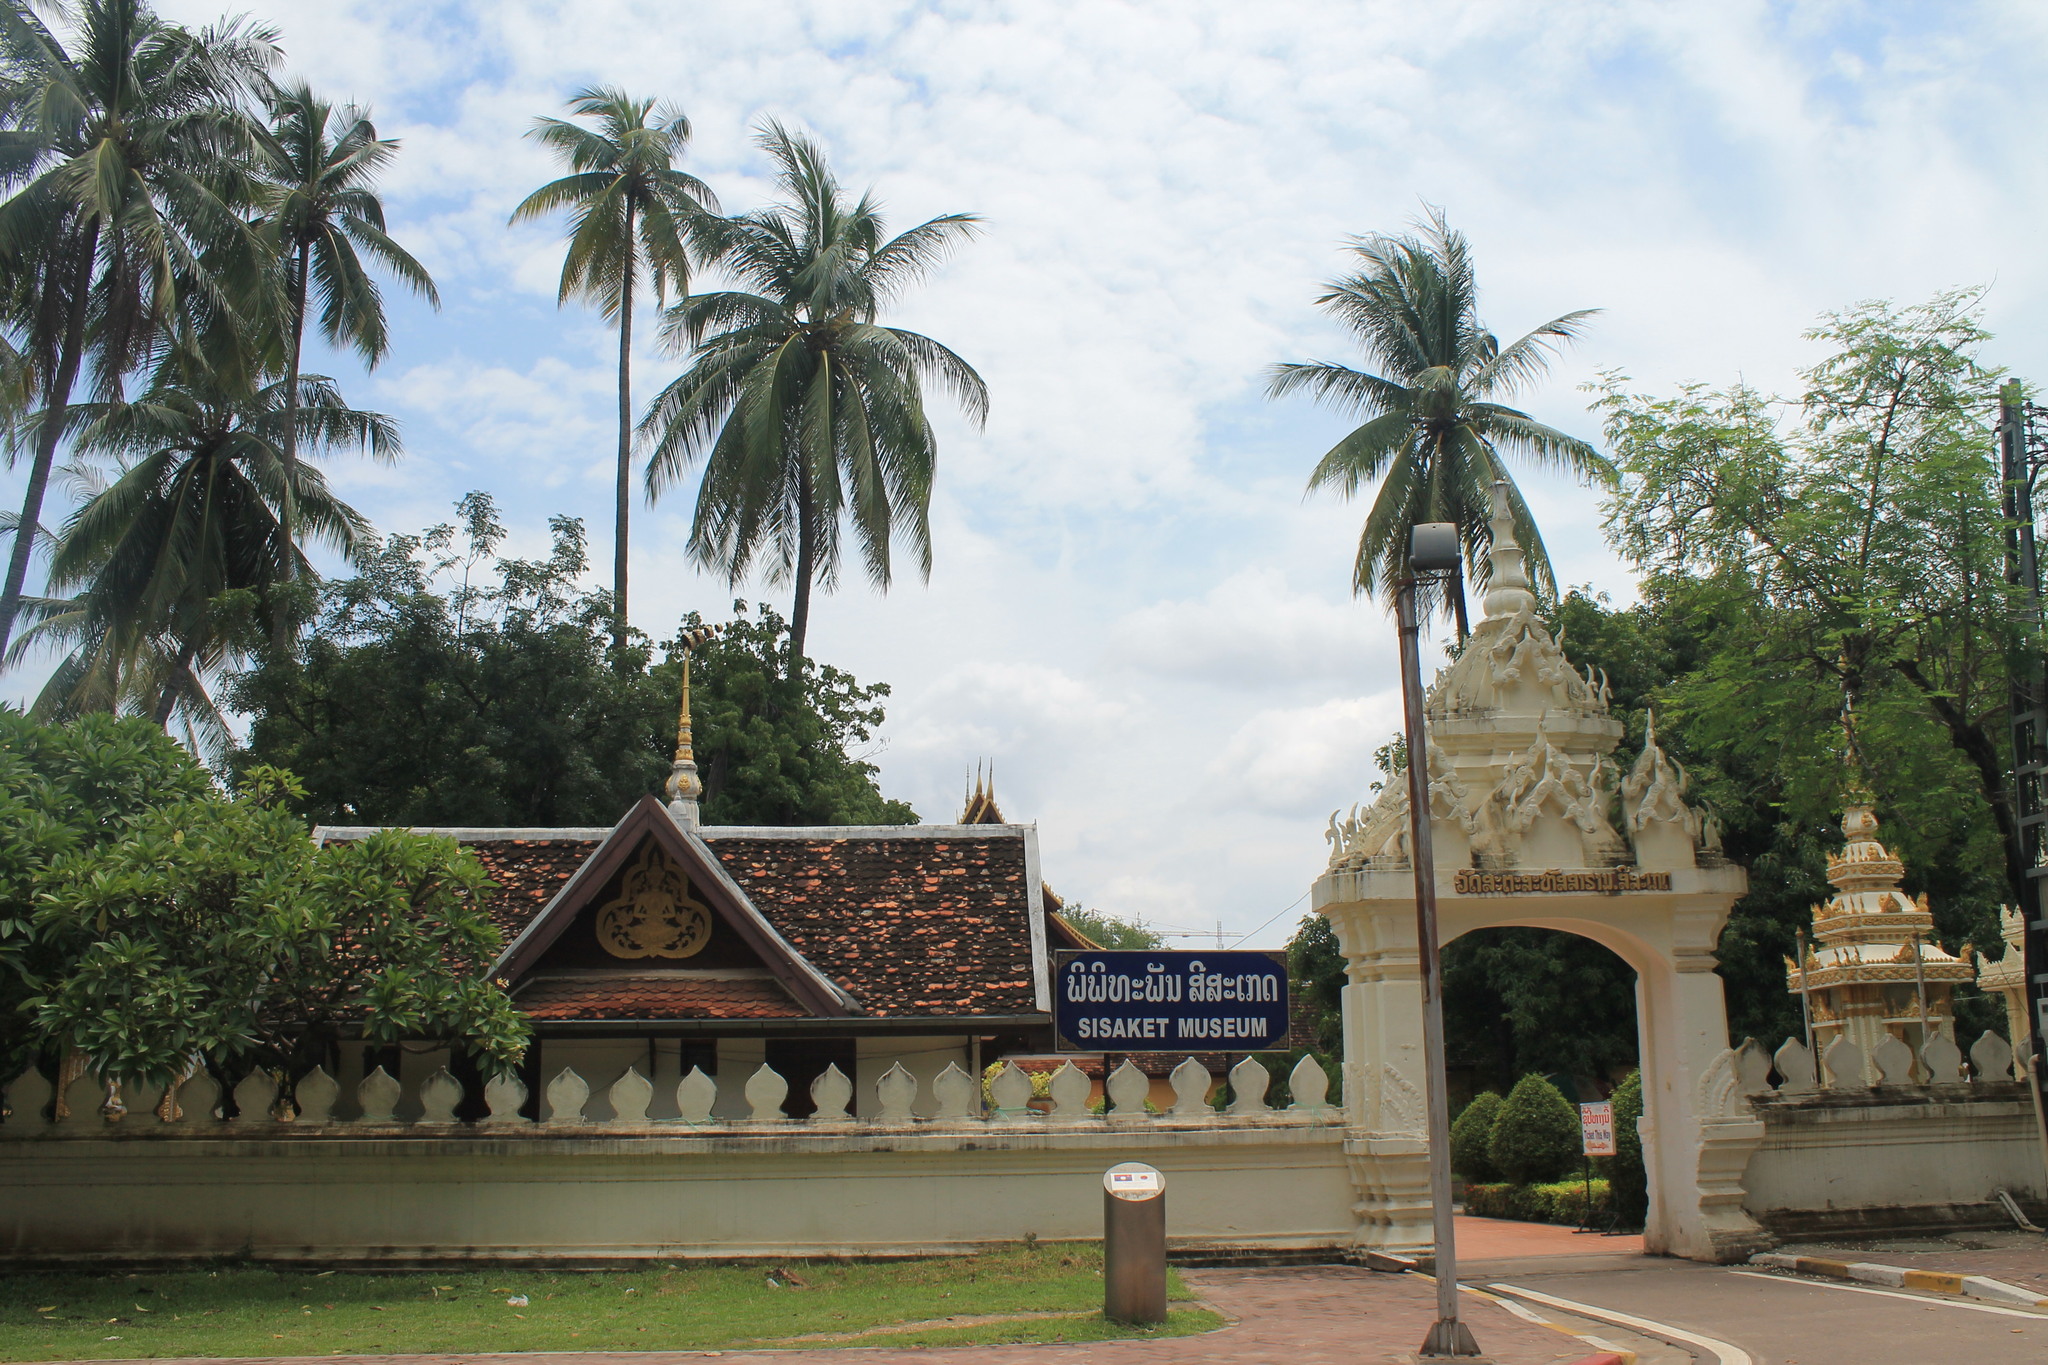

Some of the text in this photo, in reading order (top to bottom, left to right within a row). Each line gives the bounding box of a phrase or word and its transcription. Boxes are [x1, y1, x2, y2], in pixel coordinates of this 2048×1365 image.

[1067, 960, 1279, 1003] ພິພິທະພັນ ສີສະເກດ
[1078, 1017, 1268, 1038] SISAKET MUSEUM
